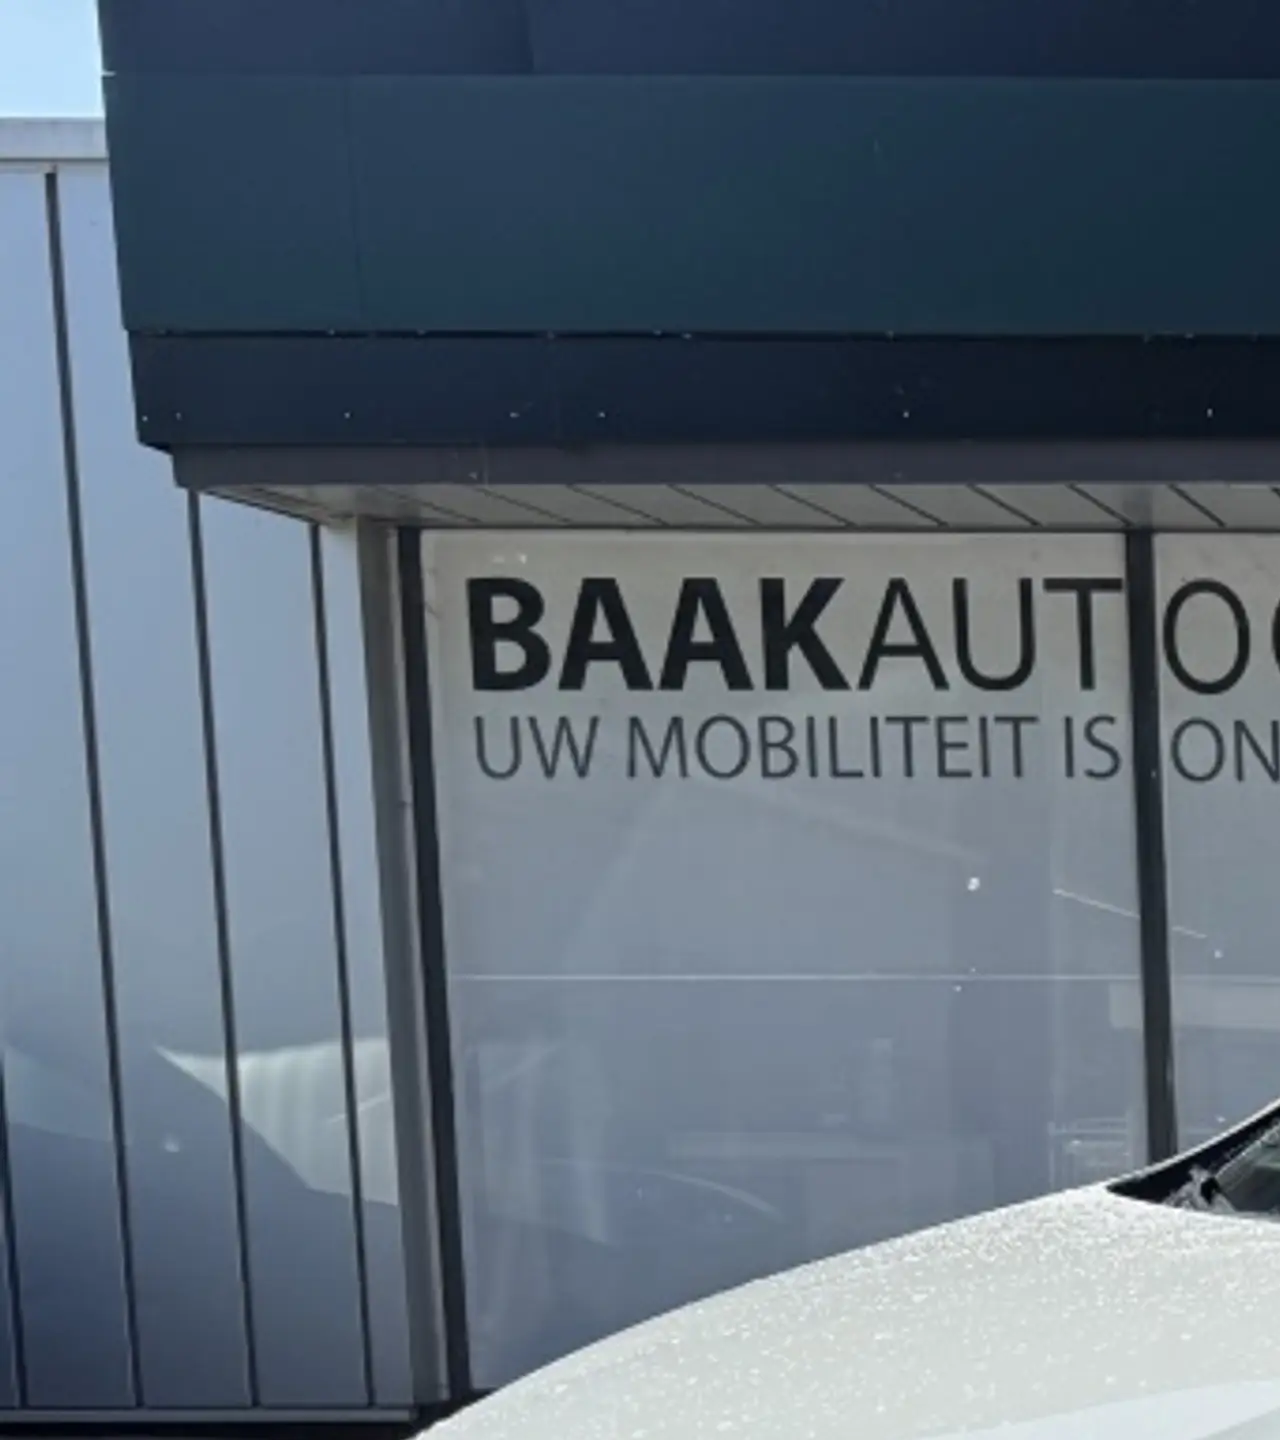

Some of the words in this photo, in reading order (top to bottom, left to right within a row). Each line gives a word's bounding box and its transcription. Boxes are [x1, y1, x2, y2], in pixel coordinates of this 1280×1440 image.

[474, 714, 601, 780] UW
[626, 713, 1039, 780] MOBILITEIT
[1063, 713, 1123, 780] IS
